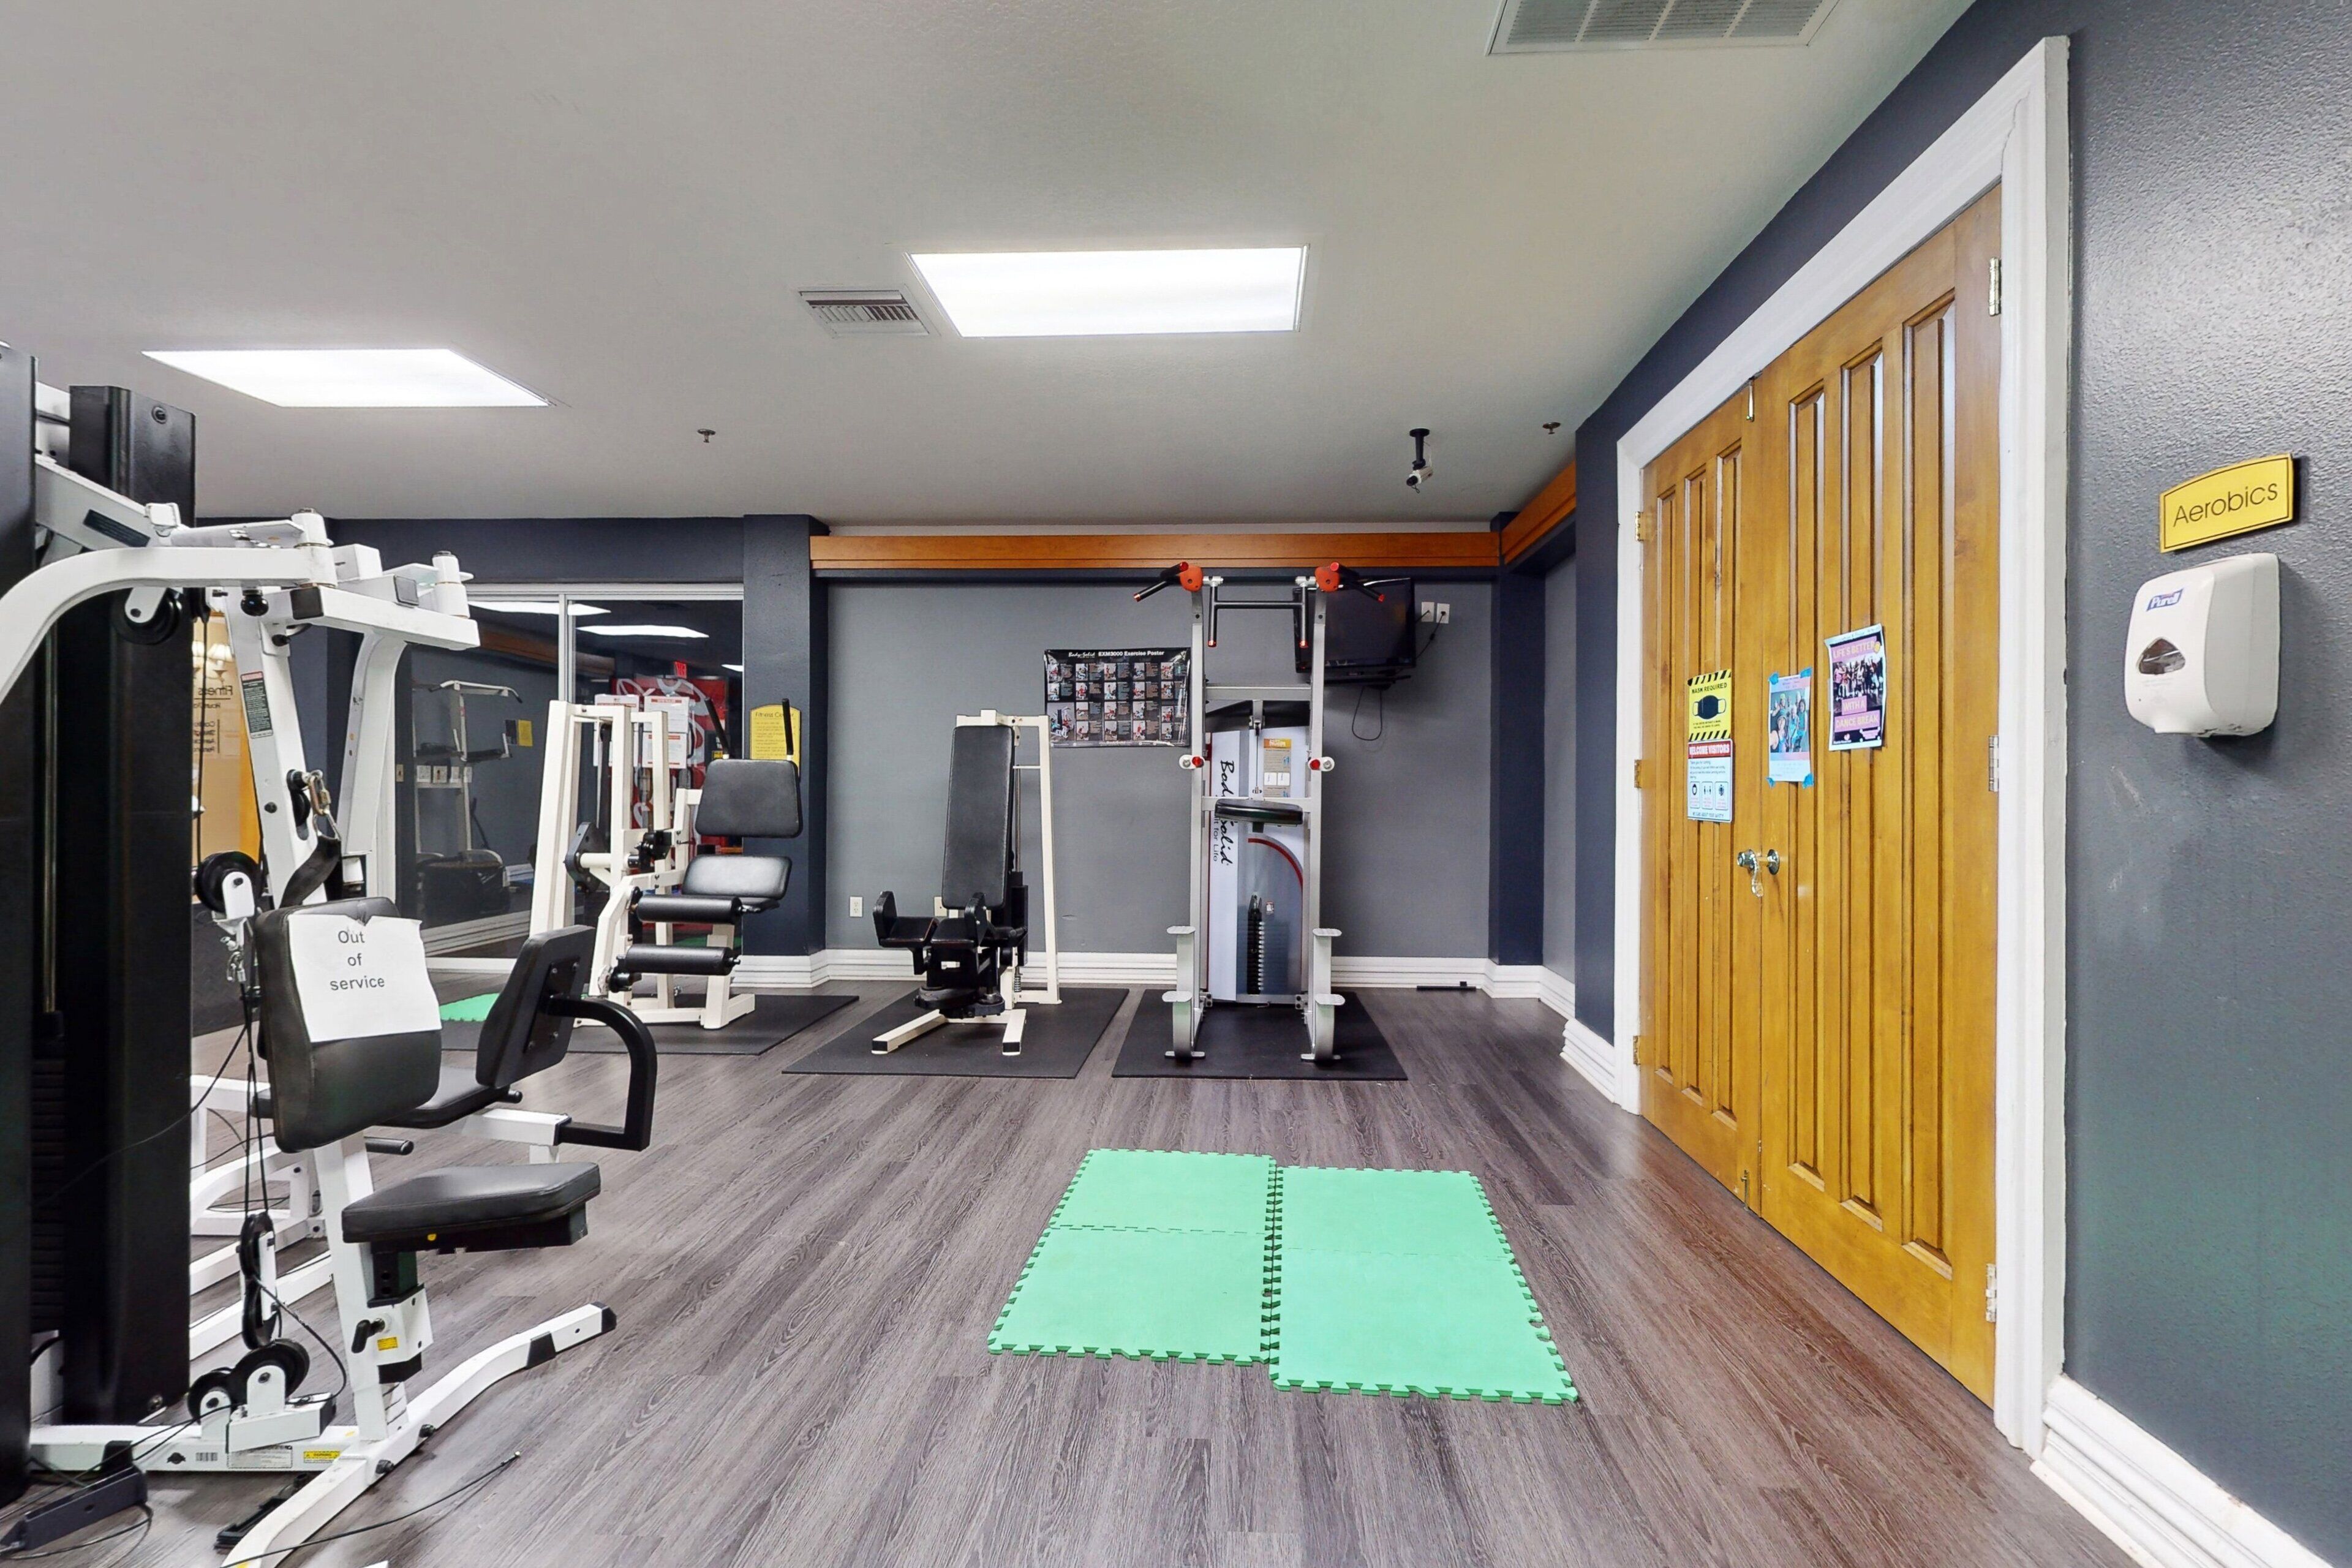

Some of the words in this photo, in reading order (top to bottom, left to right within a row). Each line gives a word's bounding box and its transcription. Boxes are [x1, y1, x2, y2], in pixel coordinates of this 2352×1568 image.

[2173, 482, 2278, 527] Aerobics
[1704, 682, 1727, 692] REQUIRED
[1708, 744, 1730, 754] VISITORS
[337, 930, 365, 944] Out
[347, 953, 363, 967] of
[330, 975, 385, 990] service
